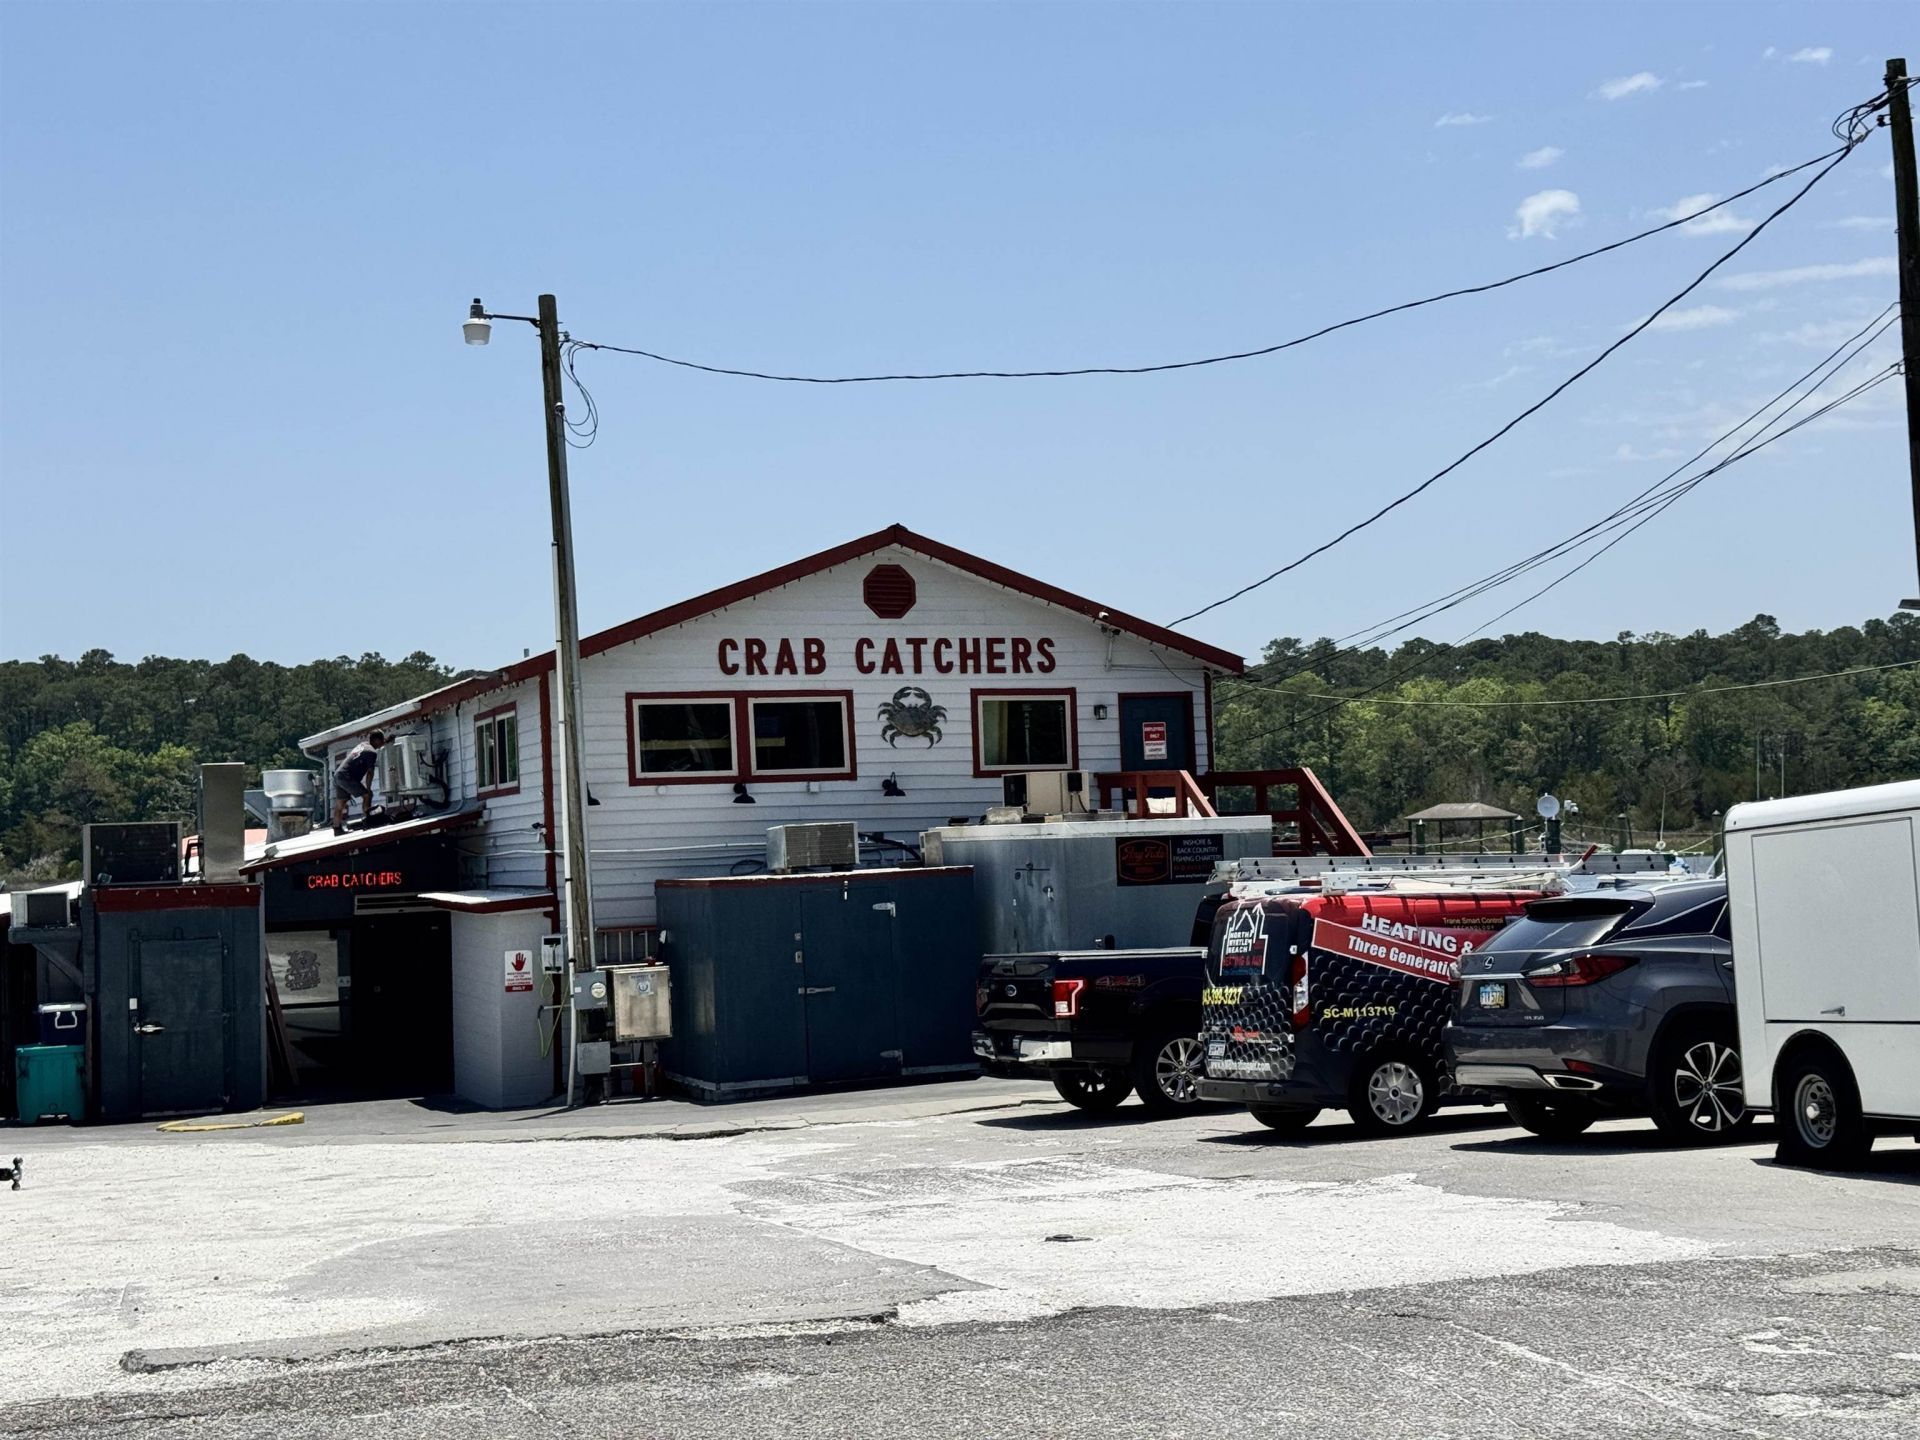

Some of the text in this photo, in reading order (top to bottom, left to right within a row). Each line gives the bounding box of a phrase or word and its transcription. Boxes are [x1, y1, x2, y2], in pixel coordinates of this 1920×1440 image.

[718, 637, 1057, 676] CRAB CATCHERS
[308, 871, 402, 889] CRAB CATCHERS
[1230, 931, 1250, 939] NORTH
[1362, 912, 1457, 953] HEATING
[1348, 934, 1387, 959] Three
[1323, 1005, 1396, 1019] SC-M113719
